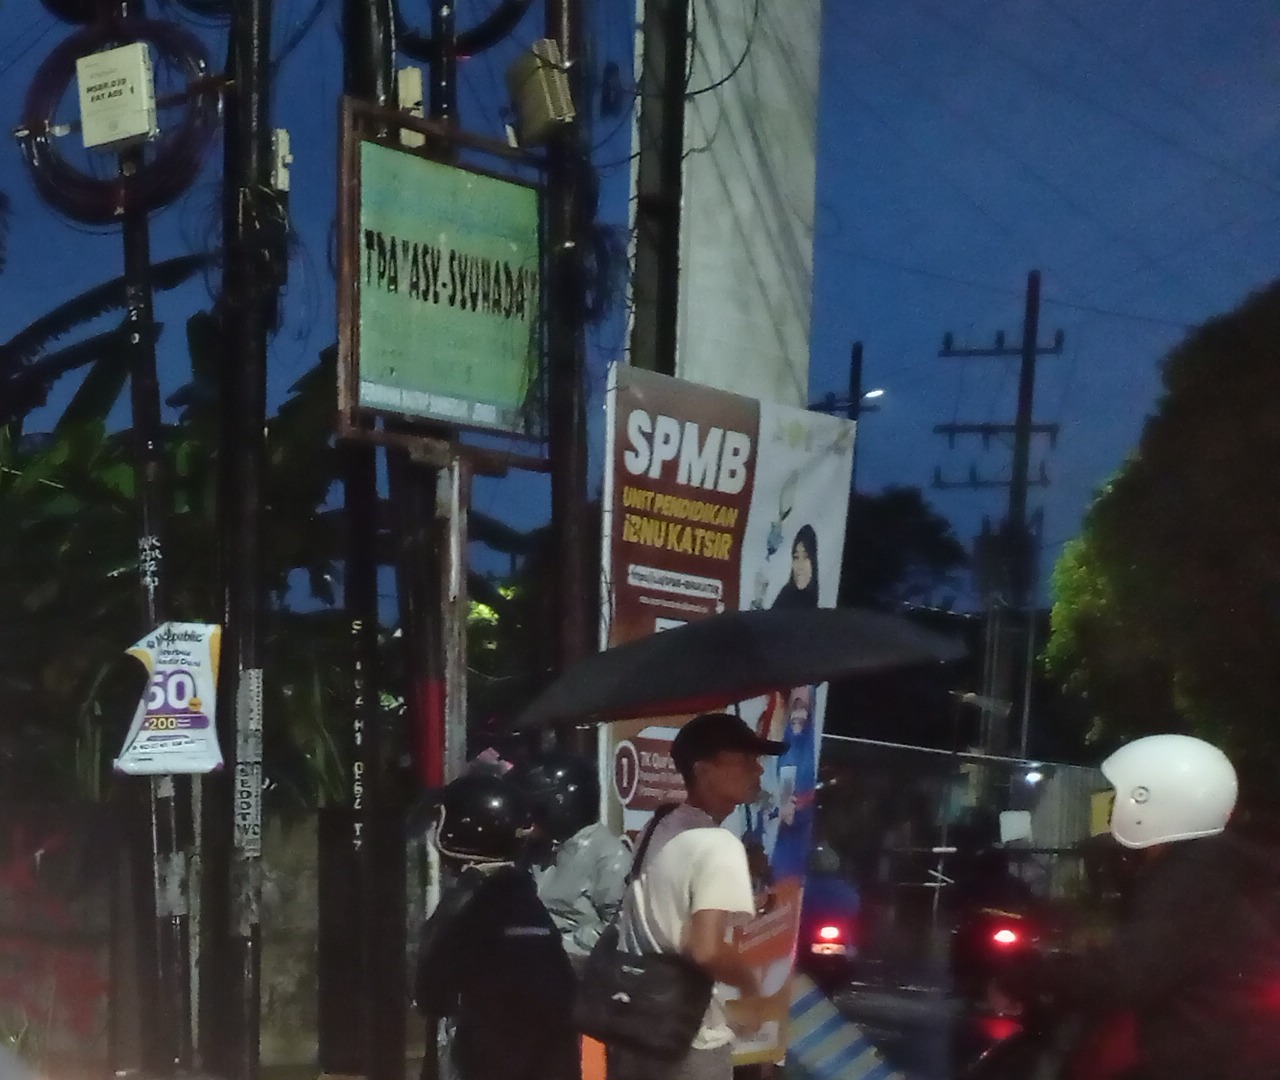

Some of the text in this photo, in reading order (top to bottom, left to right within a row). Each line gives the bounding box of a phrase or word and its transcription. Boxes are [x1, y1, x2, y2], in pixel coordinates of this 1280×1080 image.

[624, 408, 751, 494] SPMB
[623, 486, 739, 528] UNIT PENDIDIKAN
[666, 522, 734, 561] KATSIR
[621, 757, 629, 788] 1
